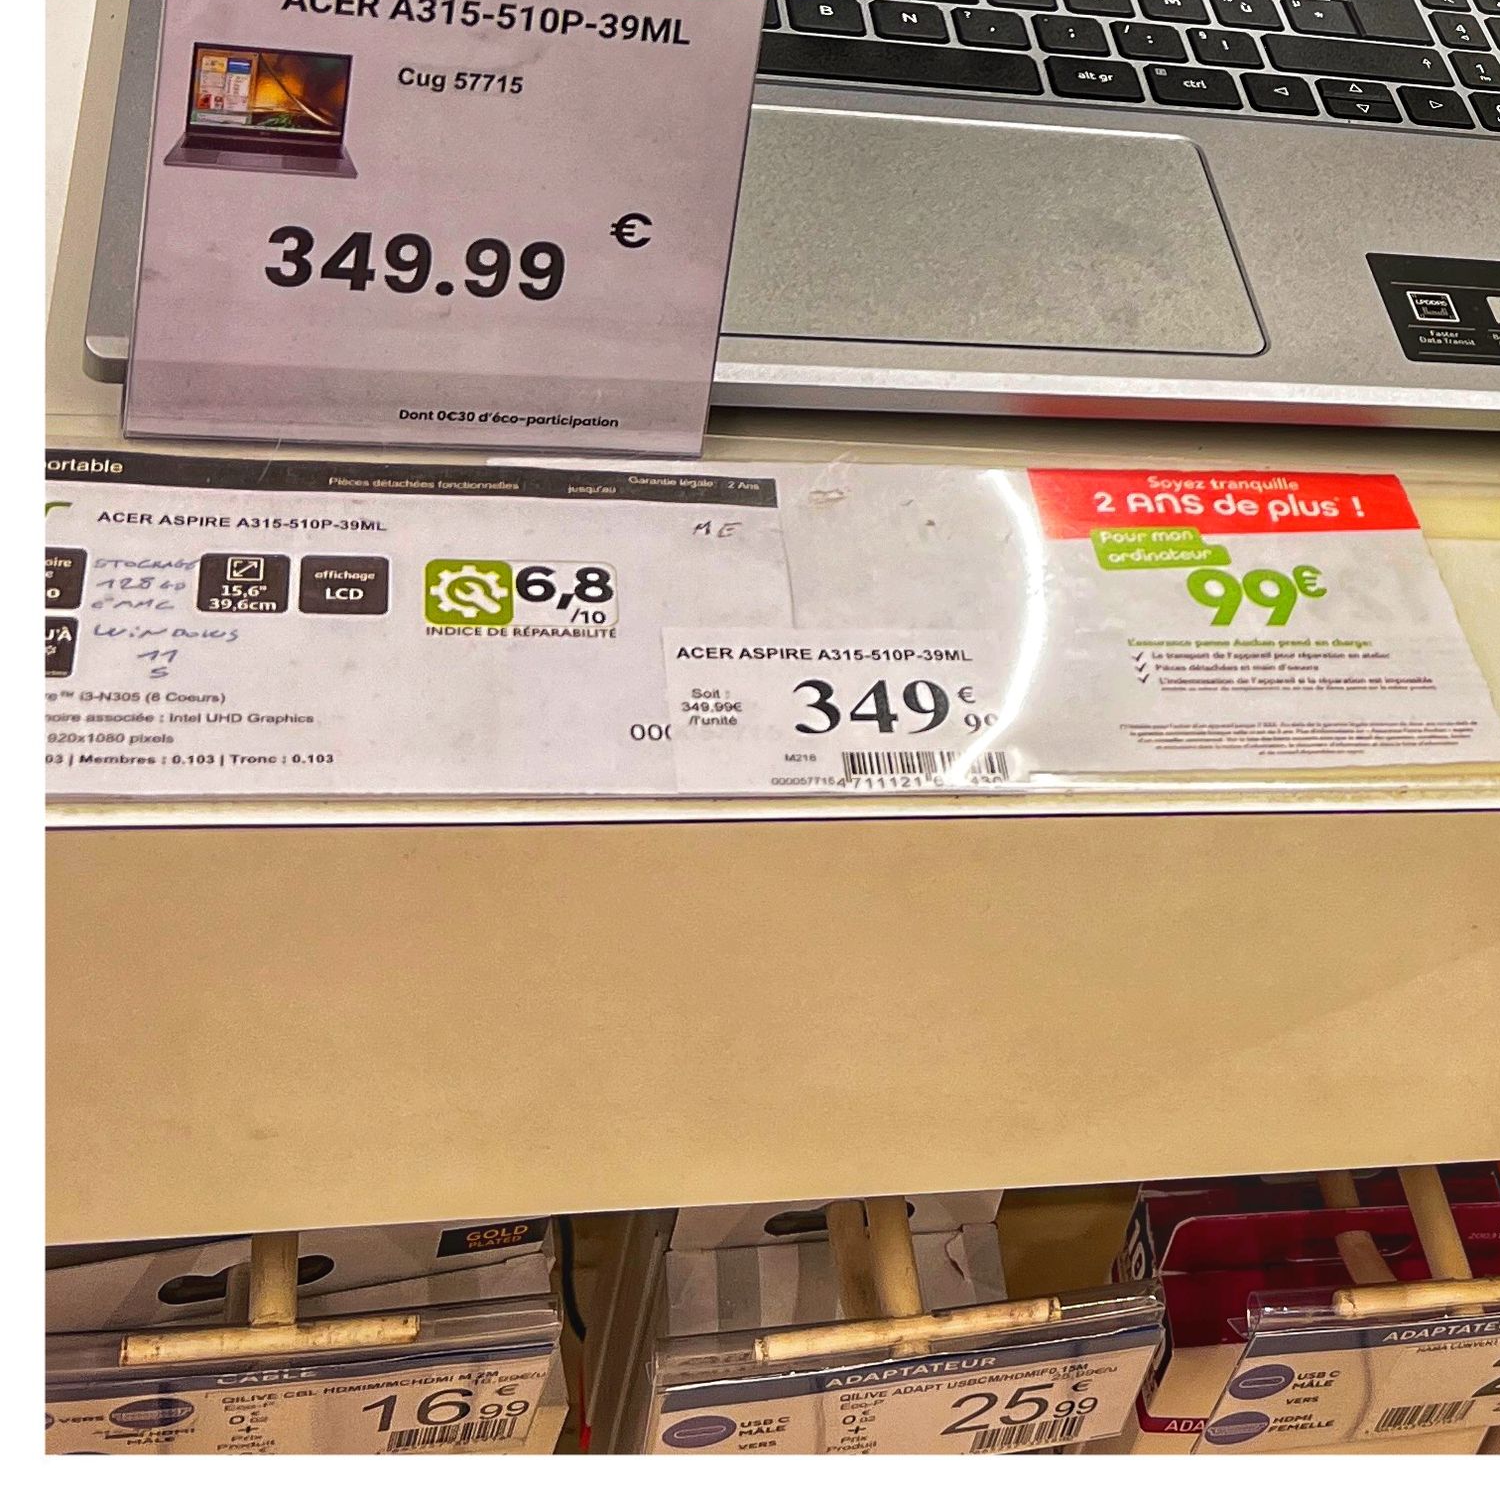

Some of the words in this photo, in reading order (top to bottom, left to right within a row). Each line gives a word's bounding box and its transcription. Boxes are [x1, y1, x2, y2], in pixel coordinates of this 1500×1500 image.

[397, 66, 447, 93] Cug
[453, 70, 524, 96] 57715
[609, 212, 653, 249] €
[263, 224, 566, 301] 349.99
[399, 408, 435, 422] Dont
[478, 412, 620, 429] d'éco-participation
[46, 458, 124, 475] ortable
[1147, 474, 1206, 493] Soyez
[1209, 476, 1300, 494] tranquille
[1095, 490, 1116, 514] 2
[1126, 493, 1205, 515] ANS
[1213, 493, 1259, 516] de
[1267, 496, 1339, 522] plus
[97, 510, 154, 526] ACER
[158, 514, 231, 529] ASPIRE
[235, 516, 388, 533] A315-510P-39ML
[1100, 530, 1147, 544] Pour
[1150, 529, 1194, 543] mon
[1107, 547, 1212, 564] ordinateur
[313, 568, 376, 583] affichage
[325, 585, 364, 602] LCD
[514, 564, 615, 611] 6,8
[208, 596, 278, 614] 39,6cm
[570, 608, 607, 626] /10
[425, 625, 483, 638] INDICE
[486, 626, 509, 638] DE
[512, 624, 618, 639] RÉPARABILITÉ
[676, 646, 734, 661] ACER
[738, 647, 813, 661] ASPIRE
[817, 649, 974, 664] A315-510P-39ML
[792, 678, 951, 736] 349
[465, 1223, 530, 1244] GOLD
[468, 1235, 523, 1249] PLATED
[825, 1357, 997, 1388] ADAPTATEUR
[1297, 1370, 1327, 1382] USB
[1292, 1376, 1334, 1391] MÂLE
[361, 1388, 474, 1433] 16
[479, 1399, 531, 1420] 99
[940, 1383, 1054, 1436] 25
[1052, 1397, 1099, 1419] 99
[1286, 1396, 1320, 1406] VERS
[1267, 1418, 1335, 1434] FEMELLE
[1272, 1413, 1314, 1426] HDMI
